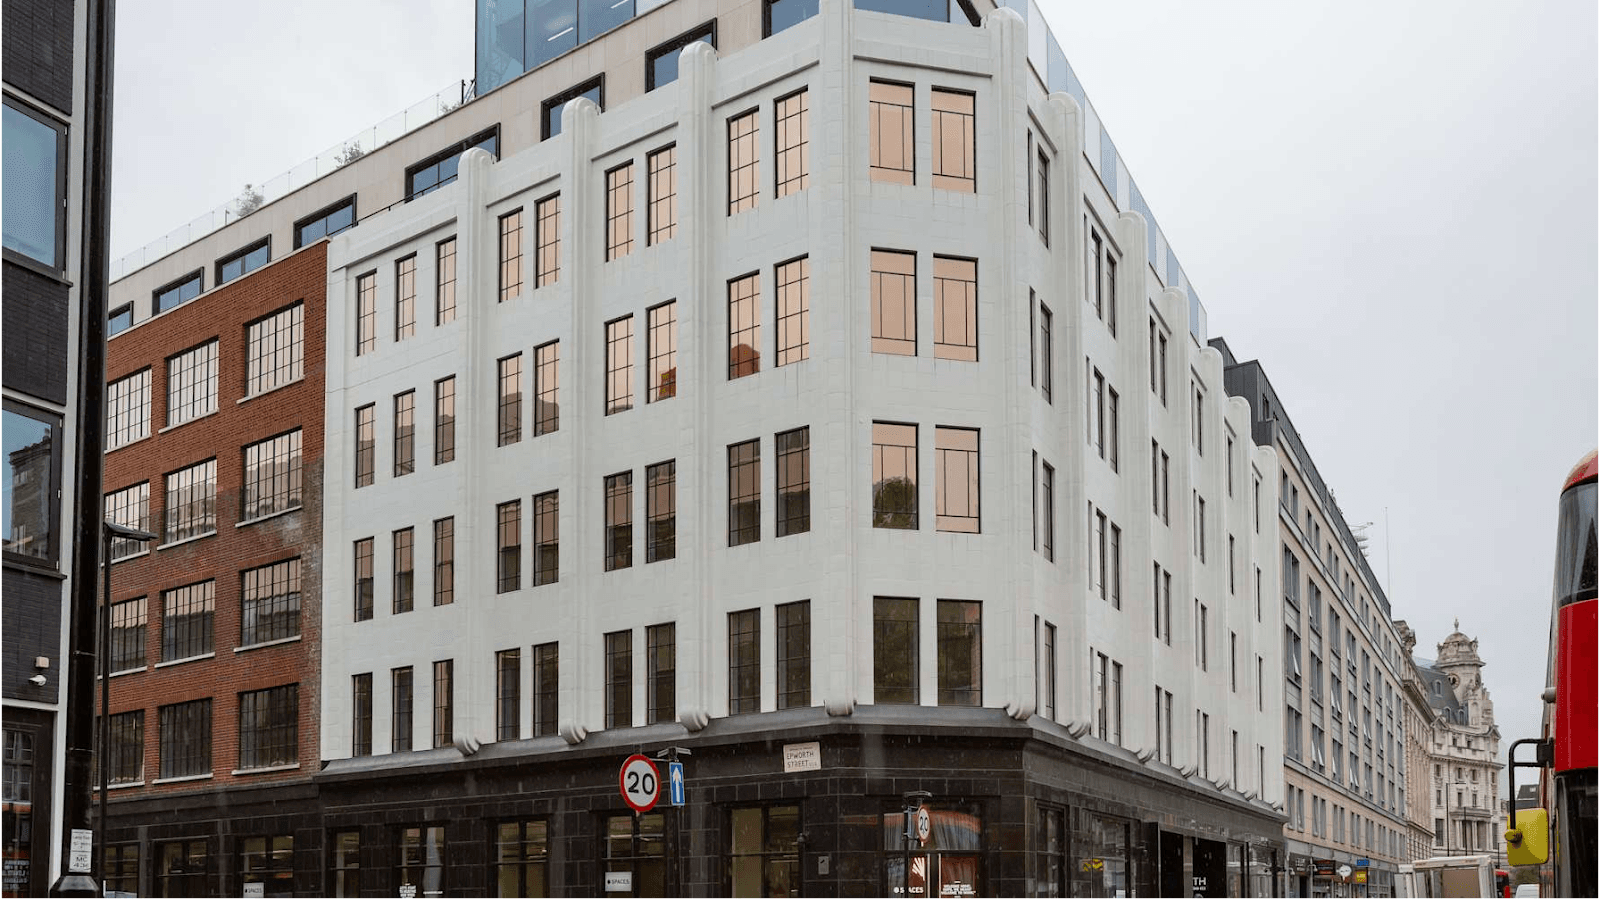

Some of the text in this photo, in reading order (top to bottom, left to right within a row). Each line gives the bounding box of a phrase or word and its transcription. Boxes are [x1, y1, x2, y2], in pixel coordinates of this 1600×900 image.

[786, 751, 814, 760] EPWORTH
[787, 759, 808, 768] STREET
[627, 771, 655, 796] 20
[919, 816, 929, 832] 20
[899, 886, 924, 894] SACES
